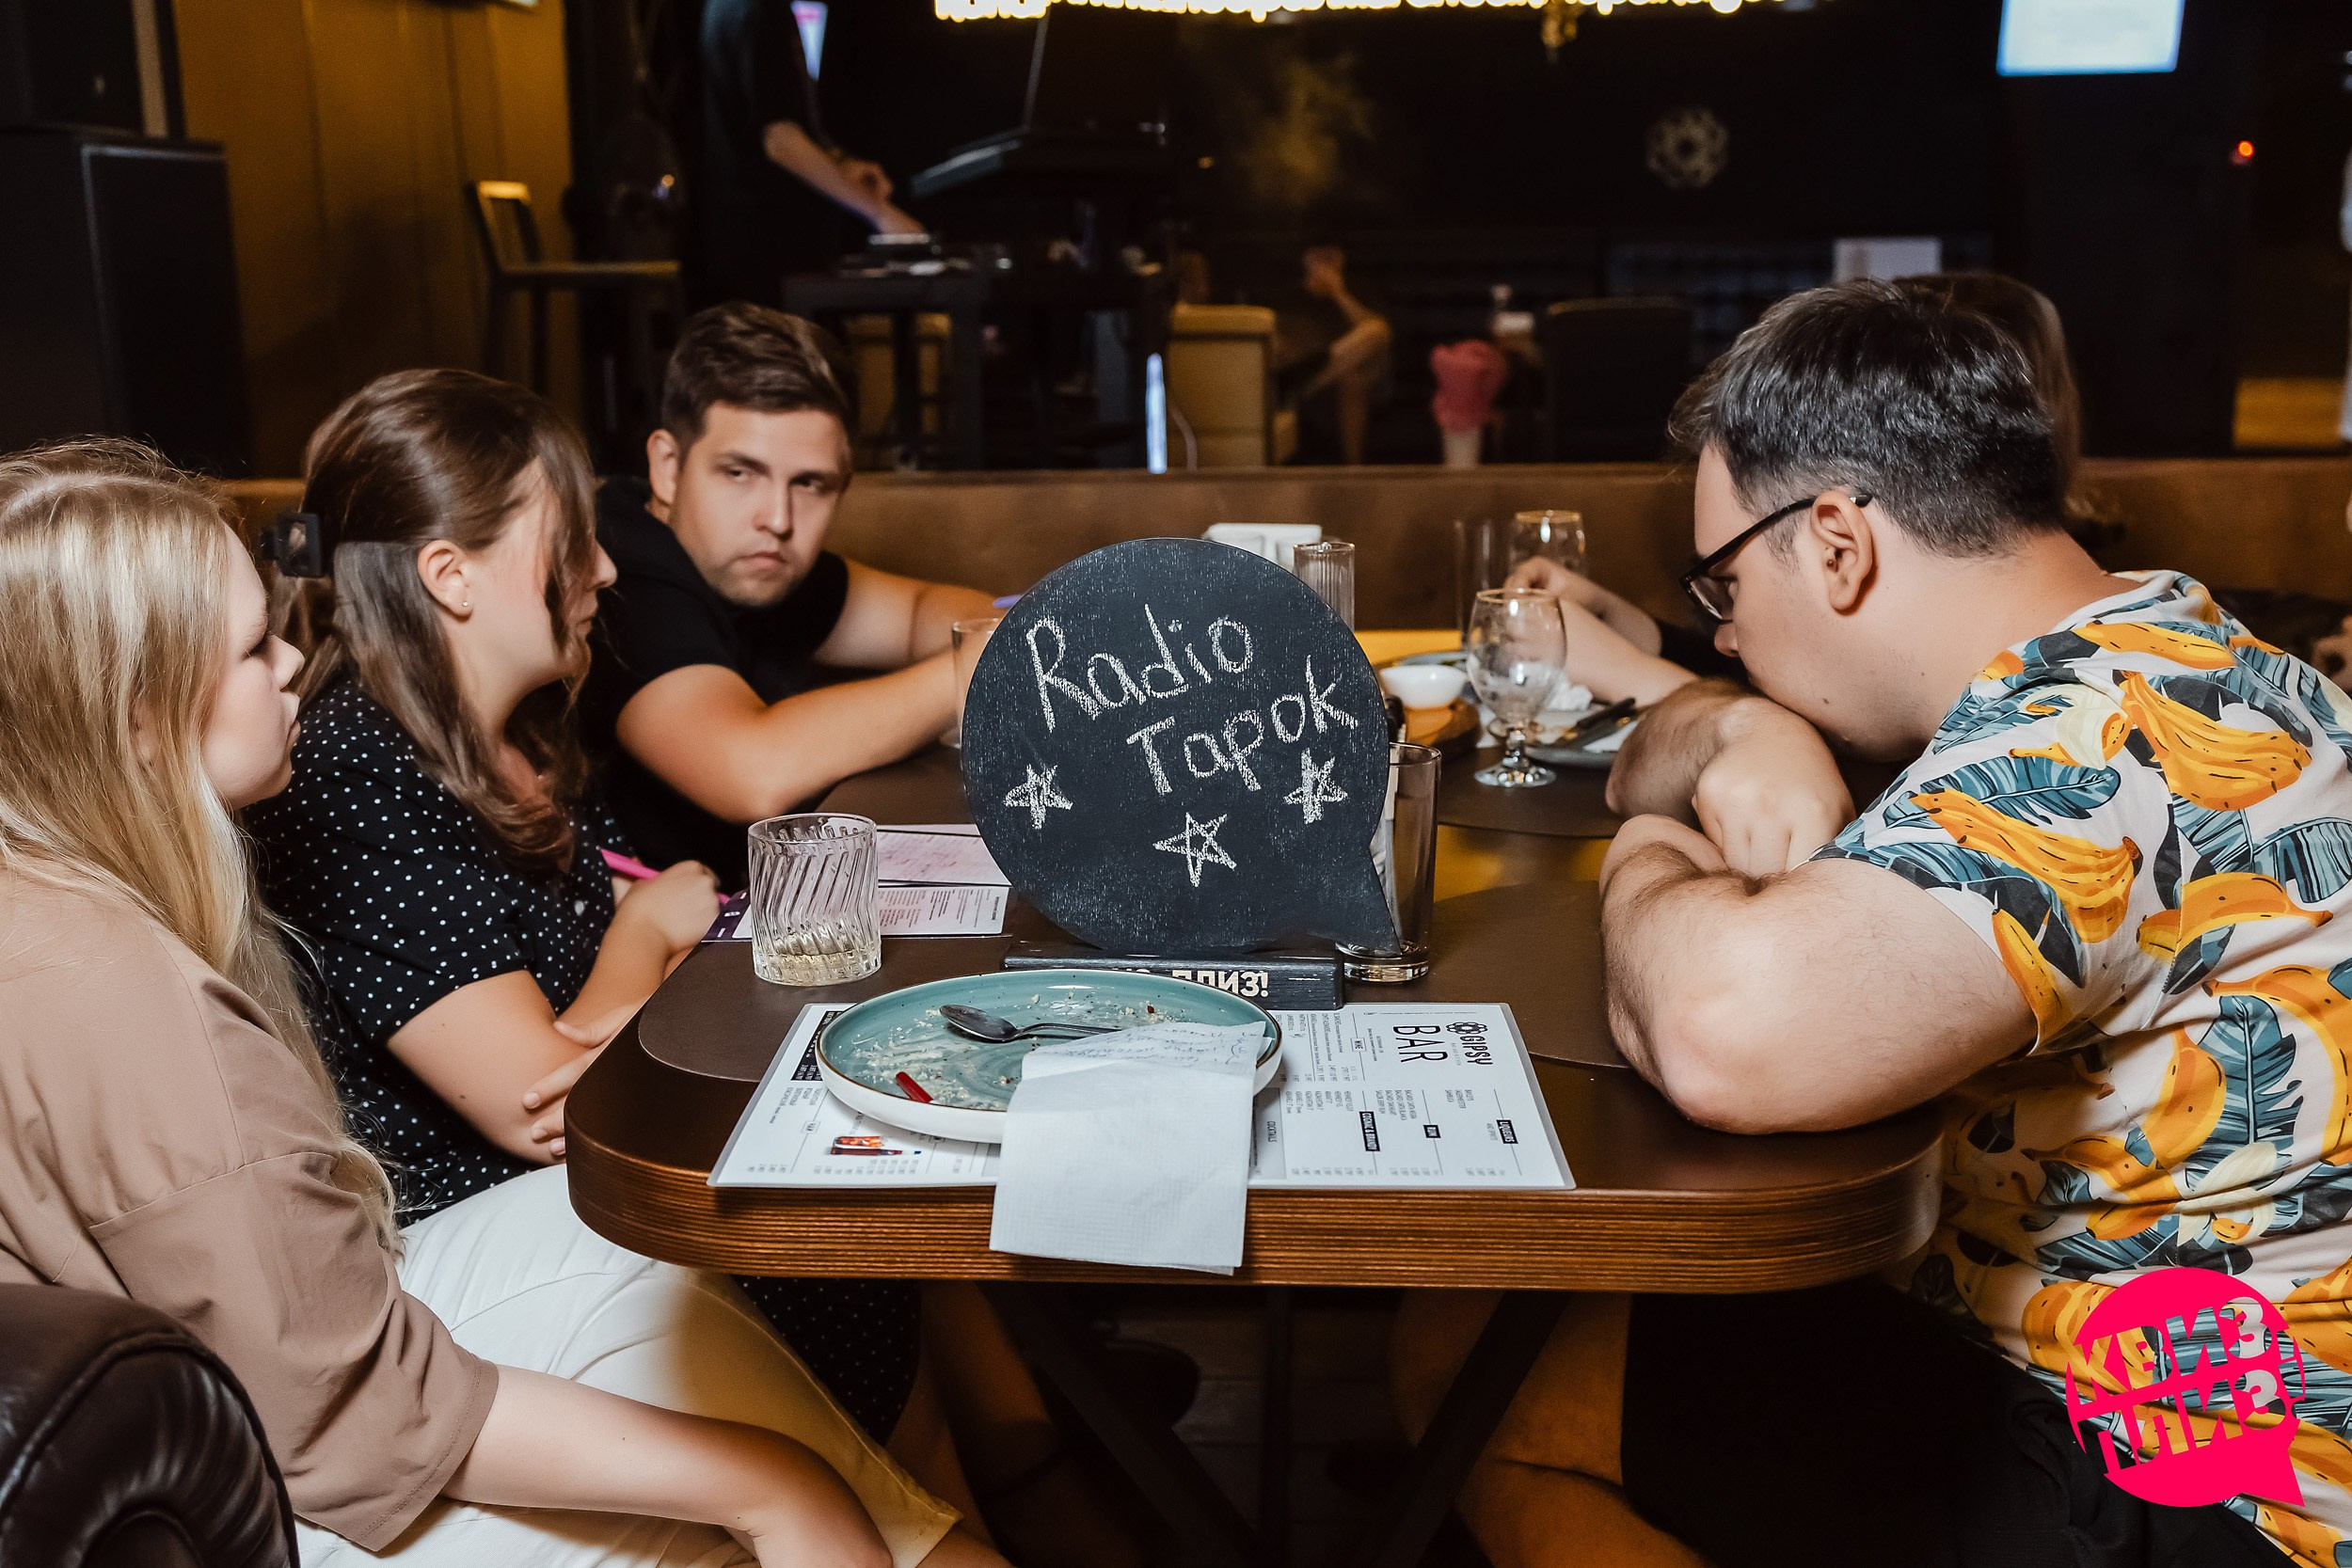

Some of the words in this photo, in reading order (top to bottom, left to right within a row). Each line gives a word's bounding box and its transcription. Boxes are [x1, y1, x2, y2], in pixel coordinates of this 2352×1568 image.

[1025, 604, 1254, 733] Radio
[1127, 655, 1359, 796] Tapok
[1393, 1025, 1448, 1062] BAR
[1460, 1036, 1493, 1066] GIPSY
[1266, 1120, 1277, 1143] COCKTAILS
[1361, 1113, 1374, 1129] COGNAC
[1498, 1120, 1516, 1143] LIQUEURS
